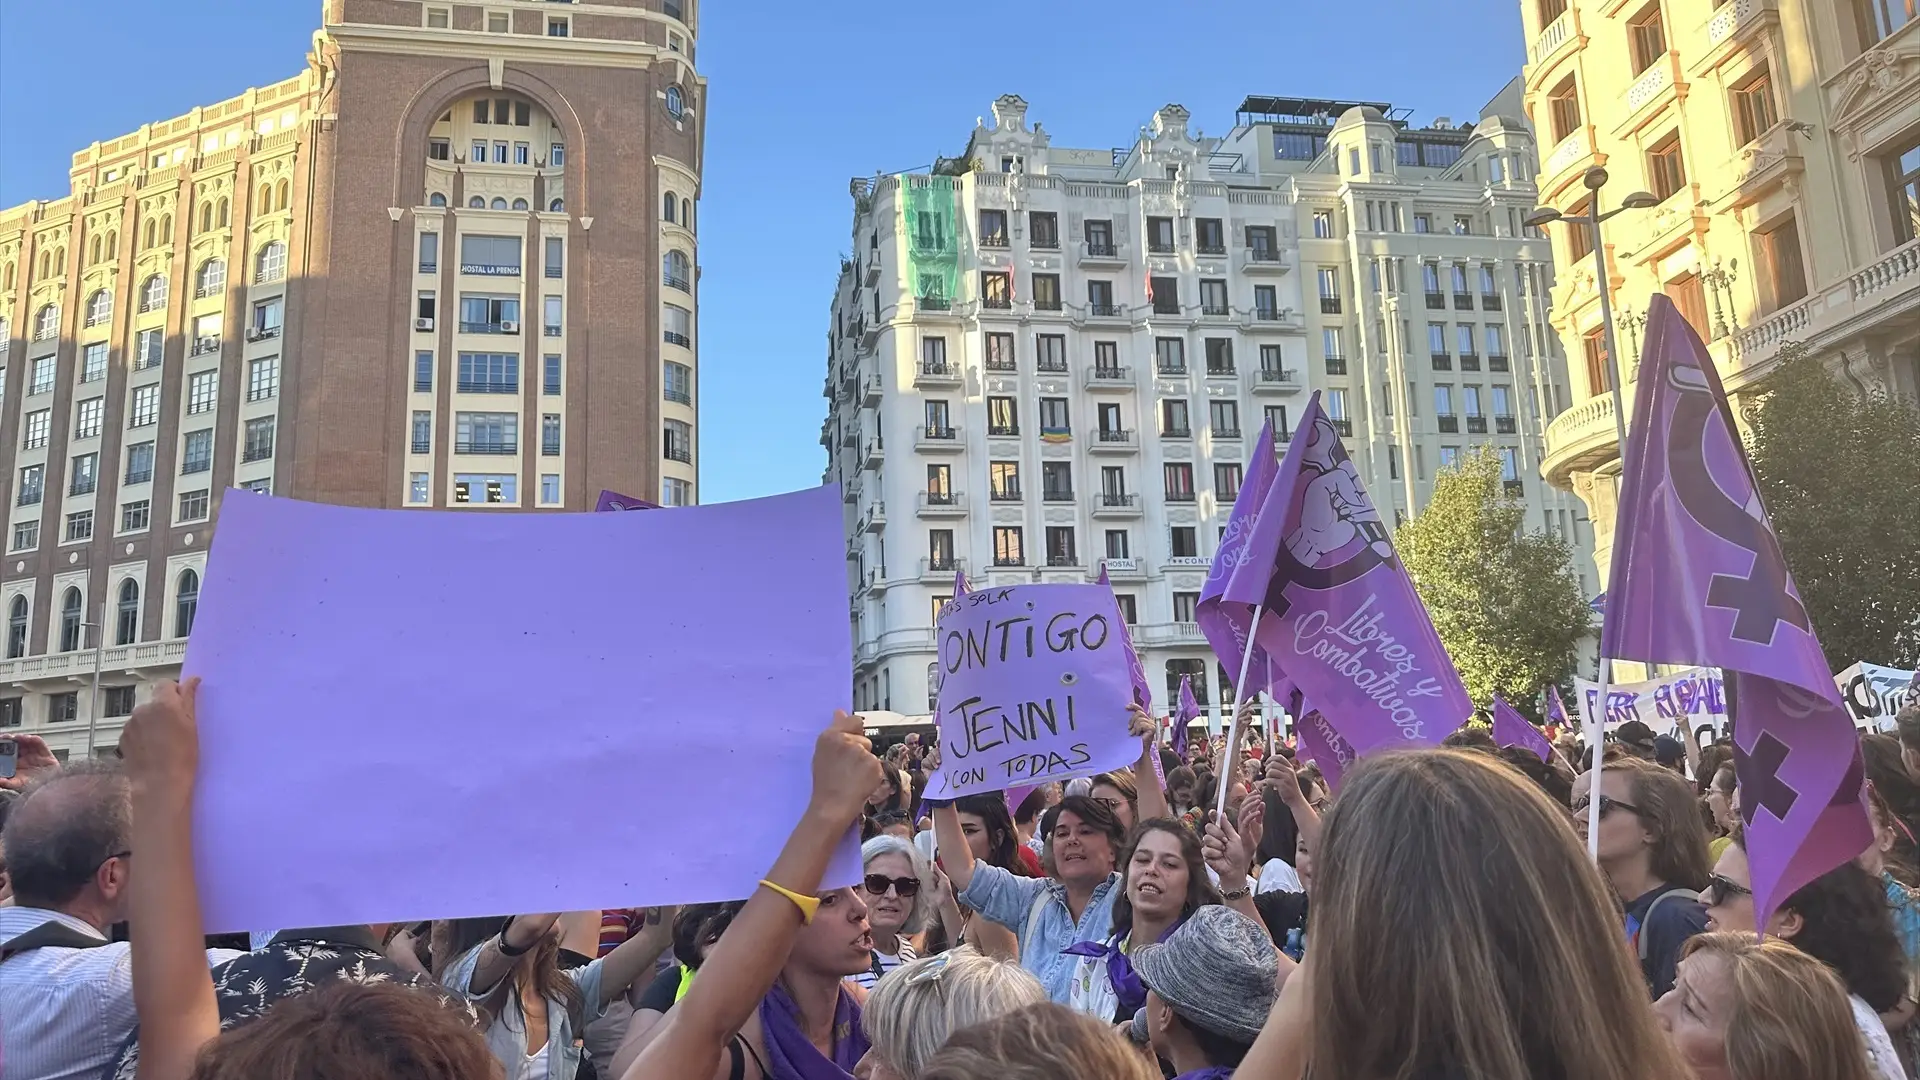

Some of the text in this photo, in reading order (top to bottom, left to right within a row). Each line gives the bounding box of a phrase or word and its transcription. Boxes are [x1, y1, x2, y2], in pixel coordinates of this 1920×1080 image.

[462, 265, 520, 275] HOSTAL LA PRENSA
[1107, 560, 1135, 568] HOSTAL
[969, 588, 1016, 607] SOLA
[1324, 593, 1421, 673] Libres
[1294, 610, 1427, 740] Combativas
[998, 743, 1091, 778] TODAS
